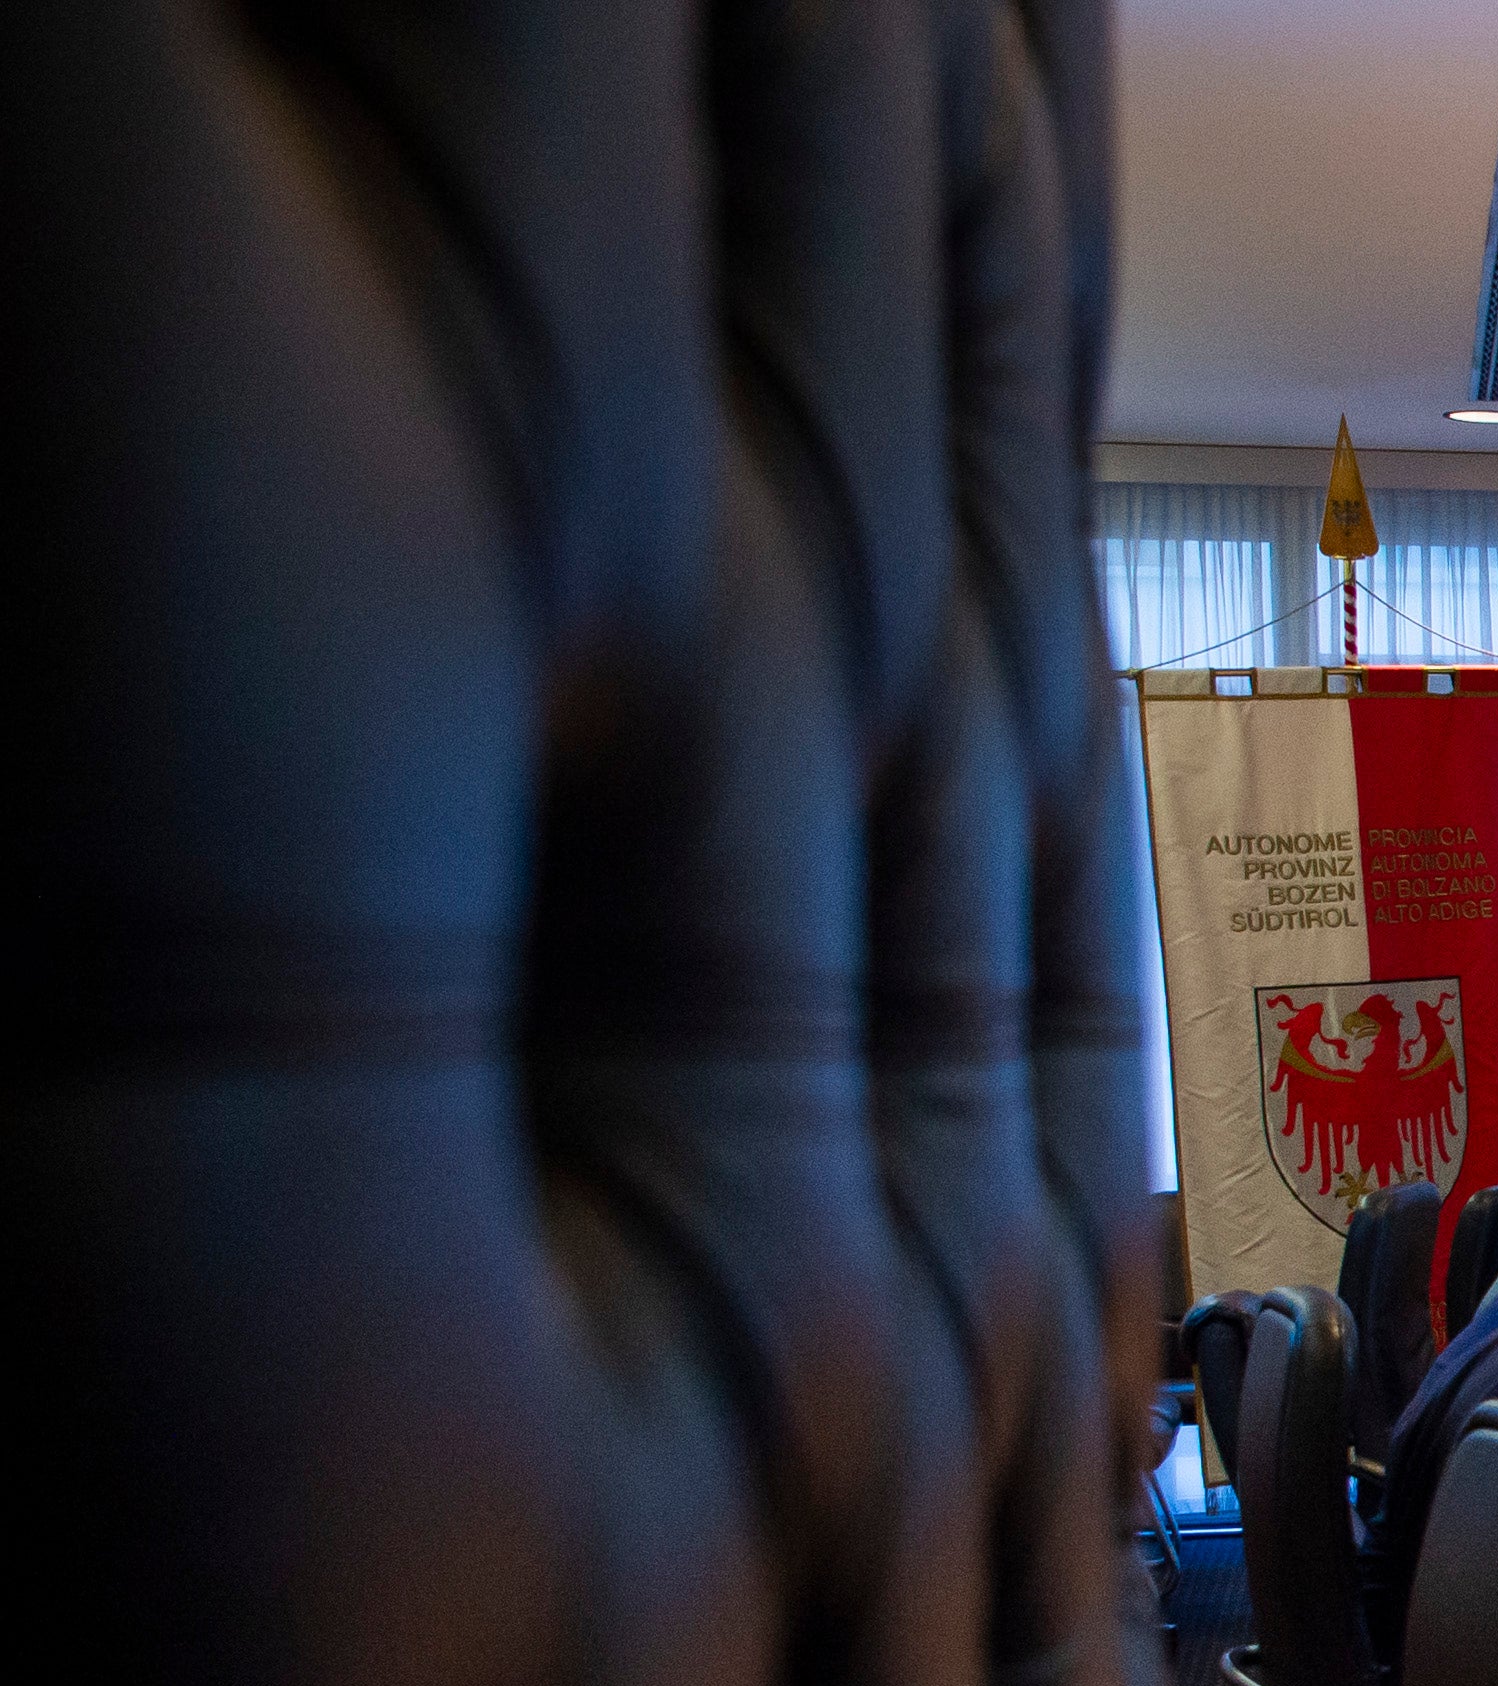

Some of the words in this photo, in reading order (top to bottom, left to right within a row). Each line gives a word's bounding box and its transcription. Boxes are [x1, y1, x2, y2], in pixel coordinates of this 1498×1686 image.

[1206, 831, 1353, 855] AUTONOME
[1368, 827, 1478, 848] PROVINCIA
[1244, 856, 1355, 880] PROVINZ
[1370, 851, 1488, 874] AUTONOMA
[1268, 882, 1356, 905] BOZEN
[1371, 881, 1391, 900] DI
[1397, 875, 1496, 898] BOLZANO
[1230, 907, 1358, 932] SÜDTIROL
[1375, 903, 1423, 923] ALTO
[1429, 899, 1493, 921] ADIGE
